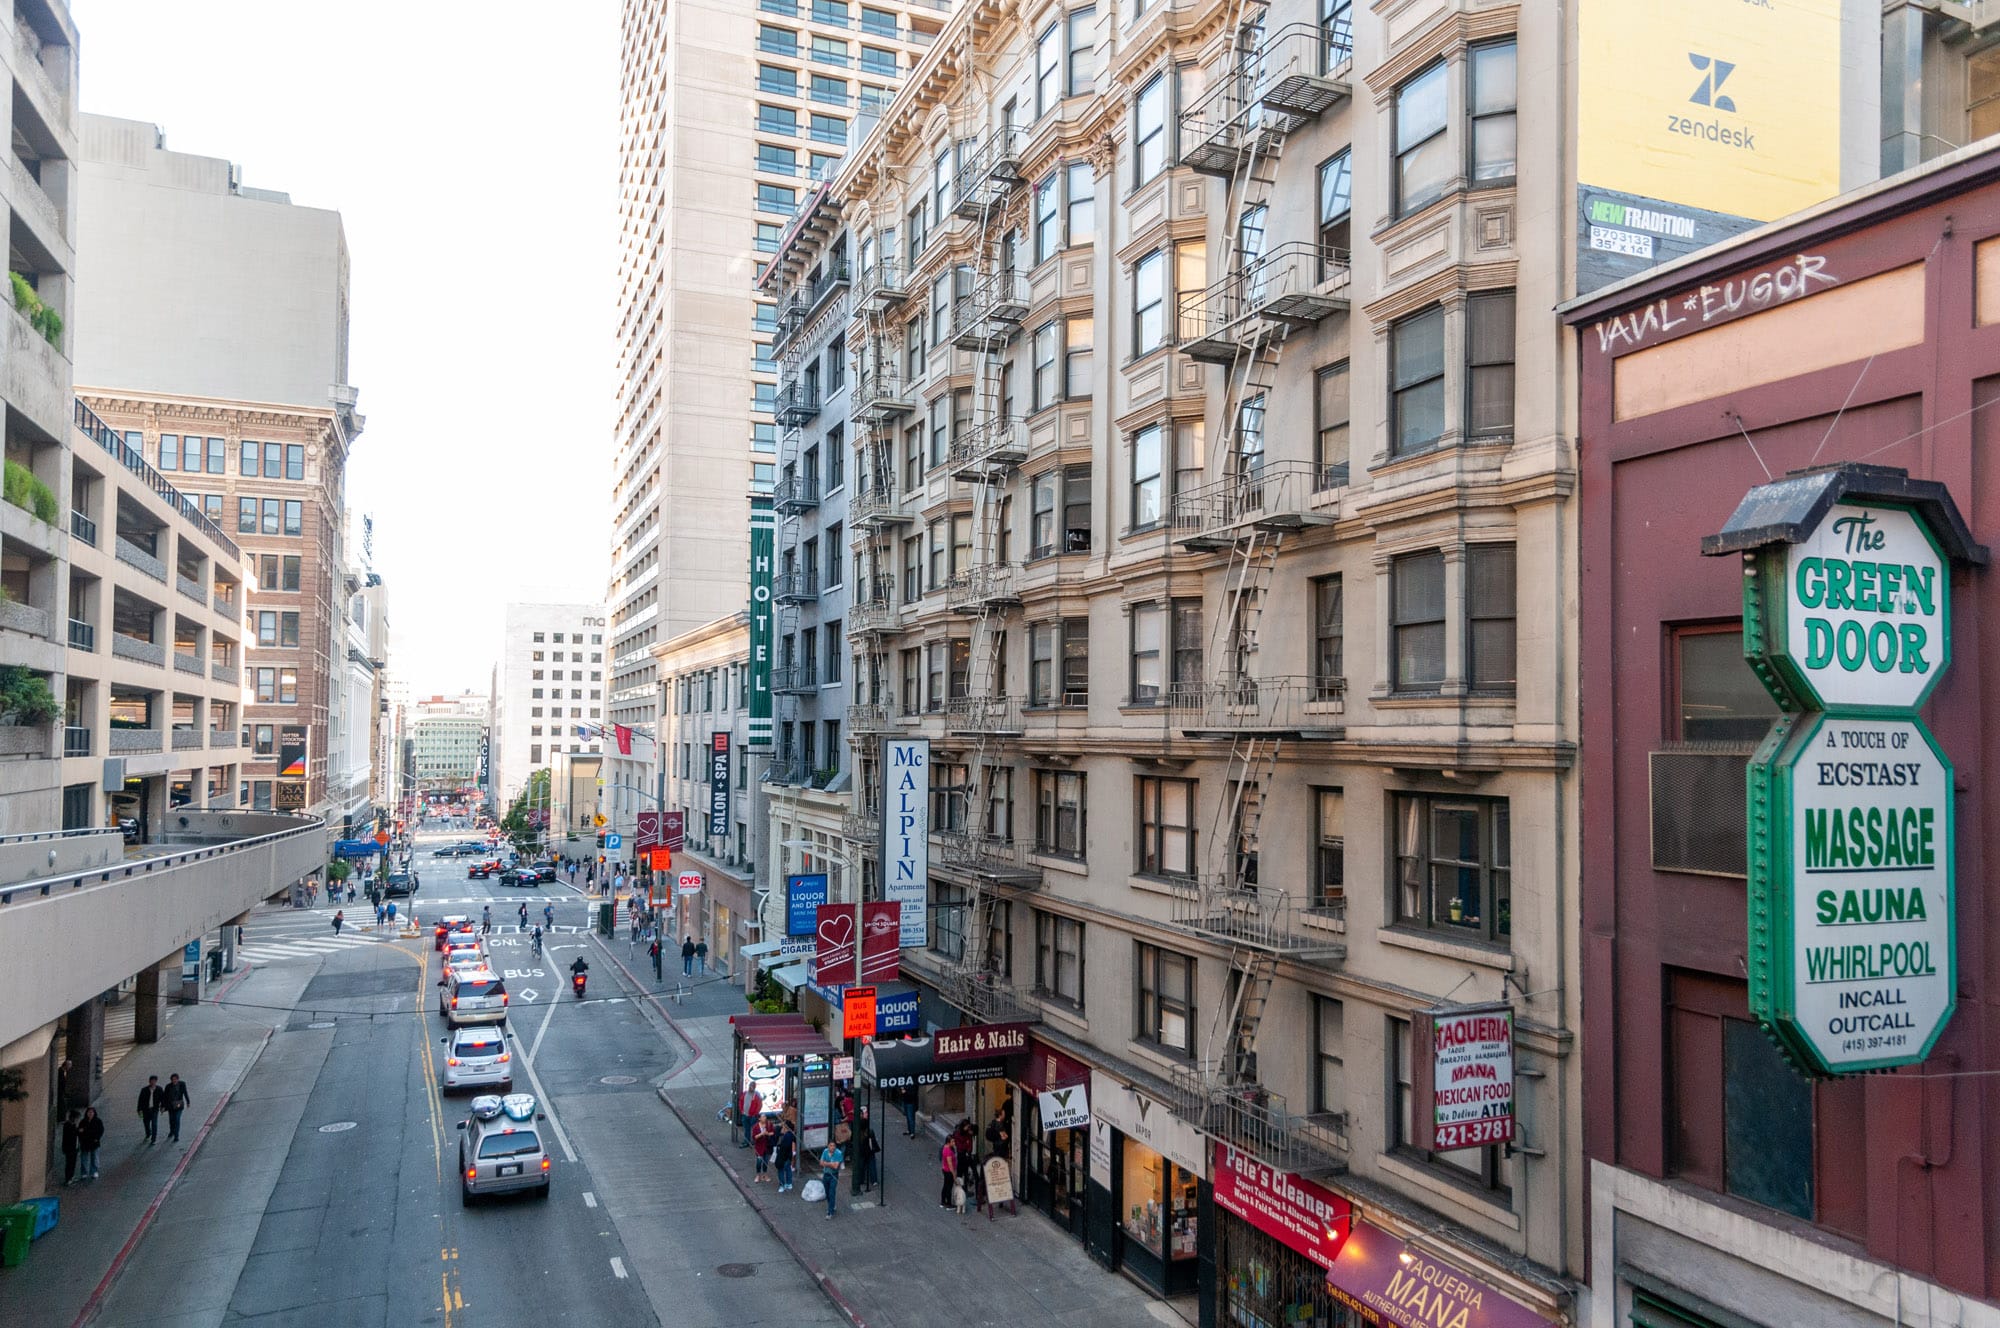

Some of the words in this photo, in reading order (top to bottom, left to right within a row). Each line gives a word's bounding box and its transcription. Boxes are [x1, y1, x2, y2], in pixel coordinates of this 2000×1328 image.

[1668, 115, 1755, 150] zendesk
[1593, 228, 1651, 246] 8703132
[1832, 510, 1886, 554] The
[1796, 556, 1936, 616] GREEN
[754, 556, 770, 691] HOTEL
[1804, 617, 1930, 674] DOOR
[1826, 731, 1836, 748] A
[1841, 731, 1886, 749] TOUCH
[1891, 732, 1910, 749] OF
[715, 754, 727, 780] SPA
[1817, 763, 1921, 786] ECSTASY
[713, 792, 727, 834] SALON
[1805, 807, 1935, 867] MASSAGE
[680, 876, 701, 885] CVS
[888, 884, 925, 892] Apartments
[791, 892, 825, 901] LIQUOR
[1816, 888, 1927, 924] SAUNA
[781, 944, 817, 954] CIGARET
[1806, 941, 1936, 981] WHIRLPOOL
[503, 968, 545, 978] BUS
[853, 1002, 867, 1010] BUS
[876, 1001, 917, 1015] LIQUOR
[1839, 989, 1907, 1009] INCALL
[849, 1023, 872, 1031] AHEAD
[851, 1012, 868, 1020] LANE
[885, 1015, 910, 1027] DELI
[1829, 1012, 1915, 1035] OUTCALL
[939, 1035, 971, 1054] Hair
[974, 1033, 985, 1050] &
[988, 1030, 1024, 1049] Nails
[1436, 1018, 1510, 1050] TAQUERIA
[1448, 1046, 1465, 1054] TACOS
[1843, 1040, 1865, 1053] (415)
[880, 1076, 914, 1088] BOBA
[918, 1072, 950, 1084] GUYS
[1452, 1064, 1497, 1083] MANA
[1435, 1085, 1481, 1106] MEXICAN
[1483, 1082, 1511, 1101] FOOD
[1054, 1108, 1076, 1118] VAPOR
[1481, 1101, 1511, 1119] ATM
[1044, 1118, 1069, 1130] SMOKE
[1070, 1114, 1088, 1125] SHOP
[1436, 1118, 1511, 1146] 421-3781
[1226, 1144, 1269, 1188] Pete's
[1272, 1169, 1334, 1223] Cleaner
[1234, 1187, 1249, 1203] Wash
[1255, 1199, 1268, 1214] Fold
[1254, 1185, 1281, 1210] Tailoring
[1287, 1204, 1319, 1230] Alteration
[1404, 1254, 1483, 1310] TAQUERIA
[1362, 1289, 1412, 1324] AUTHENTIC
[1385, 1269, 1469, 1328] MANA
